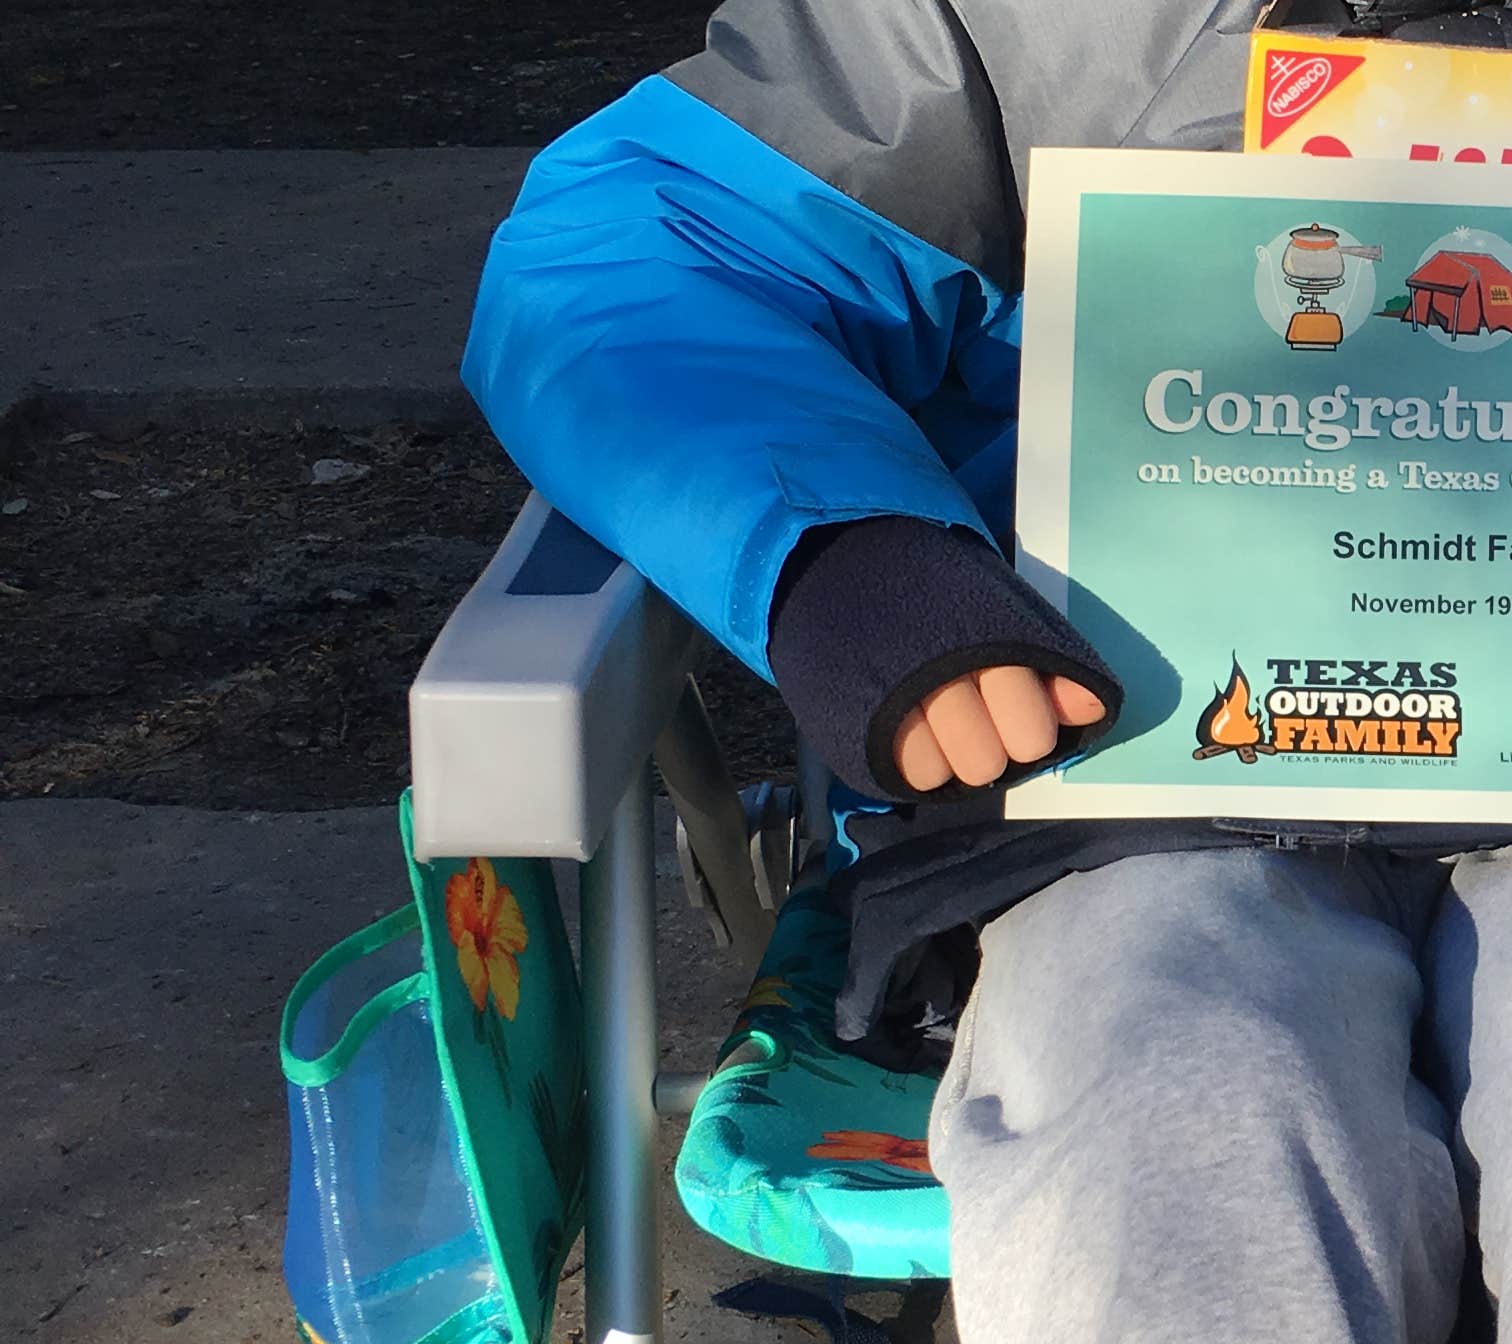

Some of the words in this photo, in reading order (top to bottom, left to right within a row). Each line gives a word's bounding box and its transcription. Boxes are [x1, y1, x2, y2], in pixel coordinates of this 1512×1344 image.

[1272, 63, 1326, 112] NABISCO
[1138, 463, 1181, 484] on
[1190, 456, 1357, 493] becoming
[1367, 467, 1389, 489] a
[1398, 461, 1500, 491] Texas
[1333, 531, 1476, 563] Schmidt
[1351, 592, 1477, 615] November
[1267, 659, 1458, 688] TEXAS
[1268, 689, 1458, 719] OUTDOOR
[1273, 717, 1460, 755] FAMILY
[1280, 756, 1320, 764] TEXAS
[1324, 756, 1366, 765] PARKS
[1371, 757, 1397, 766] AND
[1400, 758, 1458, 767] WILDLIFE
